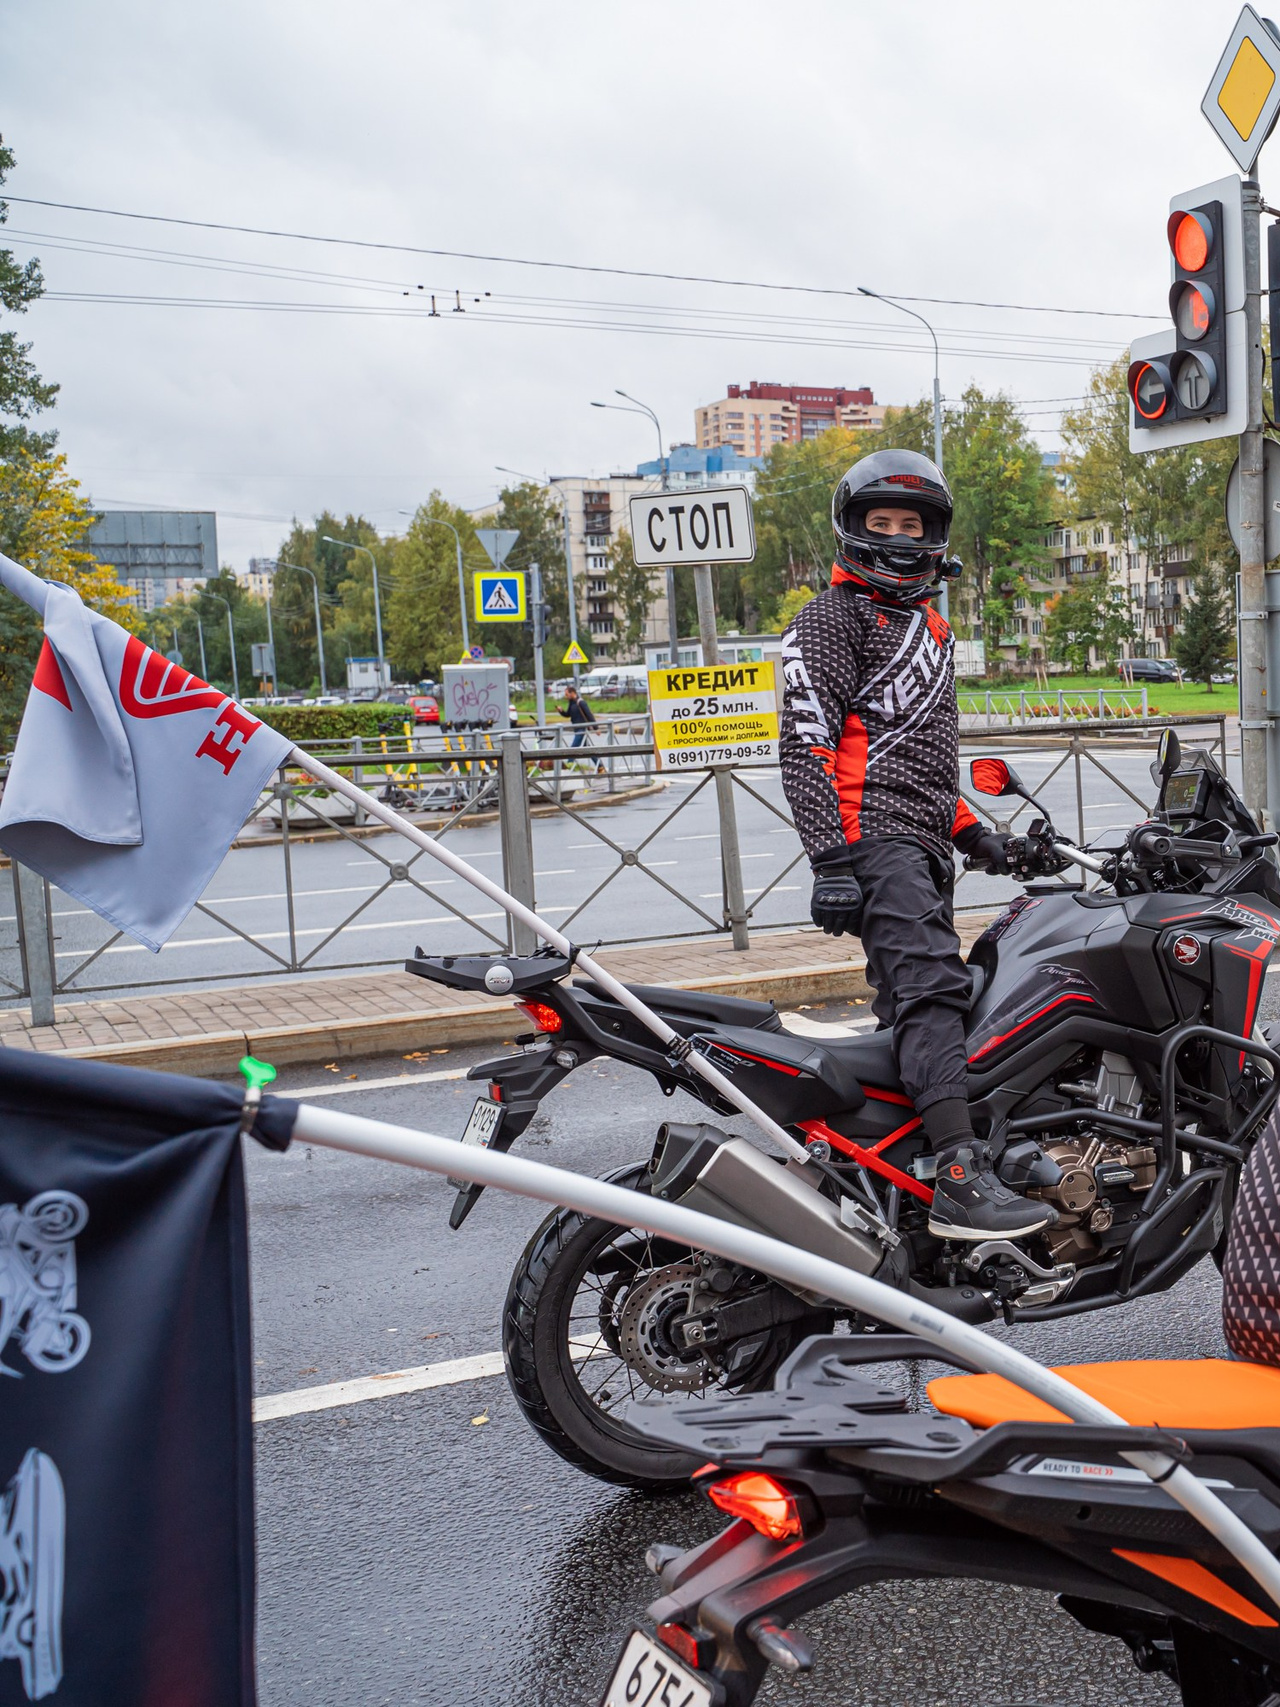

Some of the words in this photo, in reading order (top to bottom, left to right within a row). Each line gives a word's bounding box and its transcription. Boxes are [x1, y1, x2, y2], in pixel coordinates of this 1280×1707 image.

[647, 502, 735, 553] СТОП
[666, 668, 759, 692] КРЕДИТ
[671, 707, 691, 719] до
[693, 697, 719, 716] 25
[671, 721, 712, 735] 100%
[714, 720, 763, 732] помощь
[673, 734, 729, 746] ПРОСРОЧКАМИ
[736, 731, 770, 741] ДОЛГАМИ
[668, 744, 772, 766] 8(991)779-09-52
[1040, 966, 1072, 977] Africa
[1061, 976, 1086, 986] Twin
[1043, 1462, 1068, 1473] READY
[1071, 1464, 1081, 1474] TO
[1083, 1465, 1102, 1475] RACE
